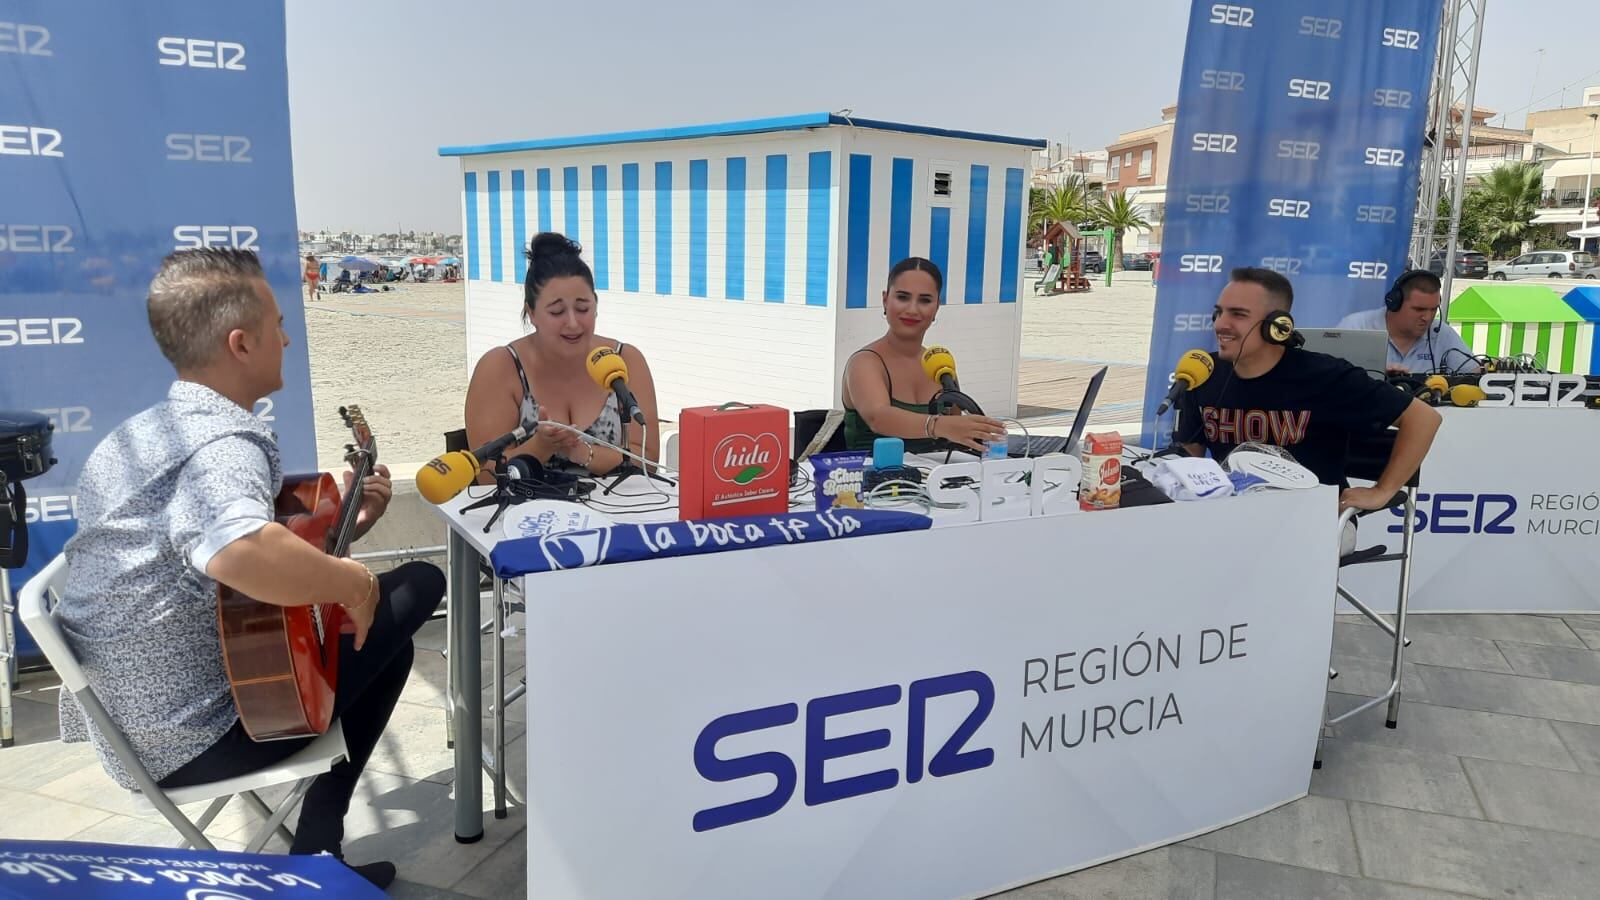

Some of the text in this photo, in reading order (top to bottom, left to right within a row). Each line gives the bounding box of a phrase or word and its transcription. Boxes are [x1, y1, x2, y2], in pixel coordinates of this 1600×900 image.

[1210, 4, 1254, 27] SER
[1299, 16, 1342, 38] SER
[1382, 27, 1420, 49] SER
[158, 37, 247, 71] SER
[1200, 69, 1245, 91] SER
[1288, 78, 1331, 100] SER
[1372, 88, 1412, 109] SER
[166, 133, 252, 163] SER
[1192, 132, 1238, 153] SER
[1277, 139, 1320, 160] SER
[1364, 147, 1405, 167] SER
[1185, 194, 1230, 213] SER
[1268, 198, 1311, 219] SER
[1356, 205, 1396, 223] SER
[173, 225, 260, 251] SER
[1180, 254, 1223, 273] SER
[1260, 256, 1302, 276] SER
[1347, 261, 1389, 280] SER
[1478, 373, 1588, 408] SER
[1202, 406, 1312, 447] SHOW
[724, 443, 770, 469] hida
[823, 479, 862, 496] Bacon
[928, 452, 1082, 521] SER
[1387, 493, 1517, 535] SER
[637, 523, 677, 552] la
[685, 519, 764, 547] boca
[769, 516, 809, 541] te
[1023, 623, 1249, 697] REGIÓN DE
[1020, 691, 1183, 759] MURCIA
[692, 669, 996, 833] SER
[89, 864, 155, 884] te
[156, 869, 274, 892] boca
[267, 874, 322, 890] la
